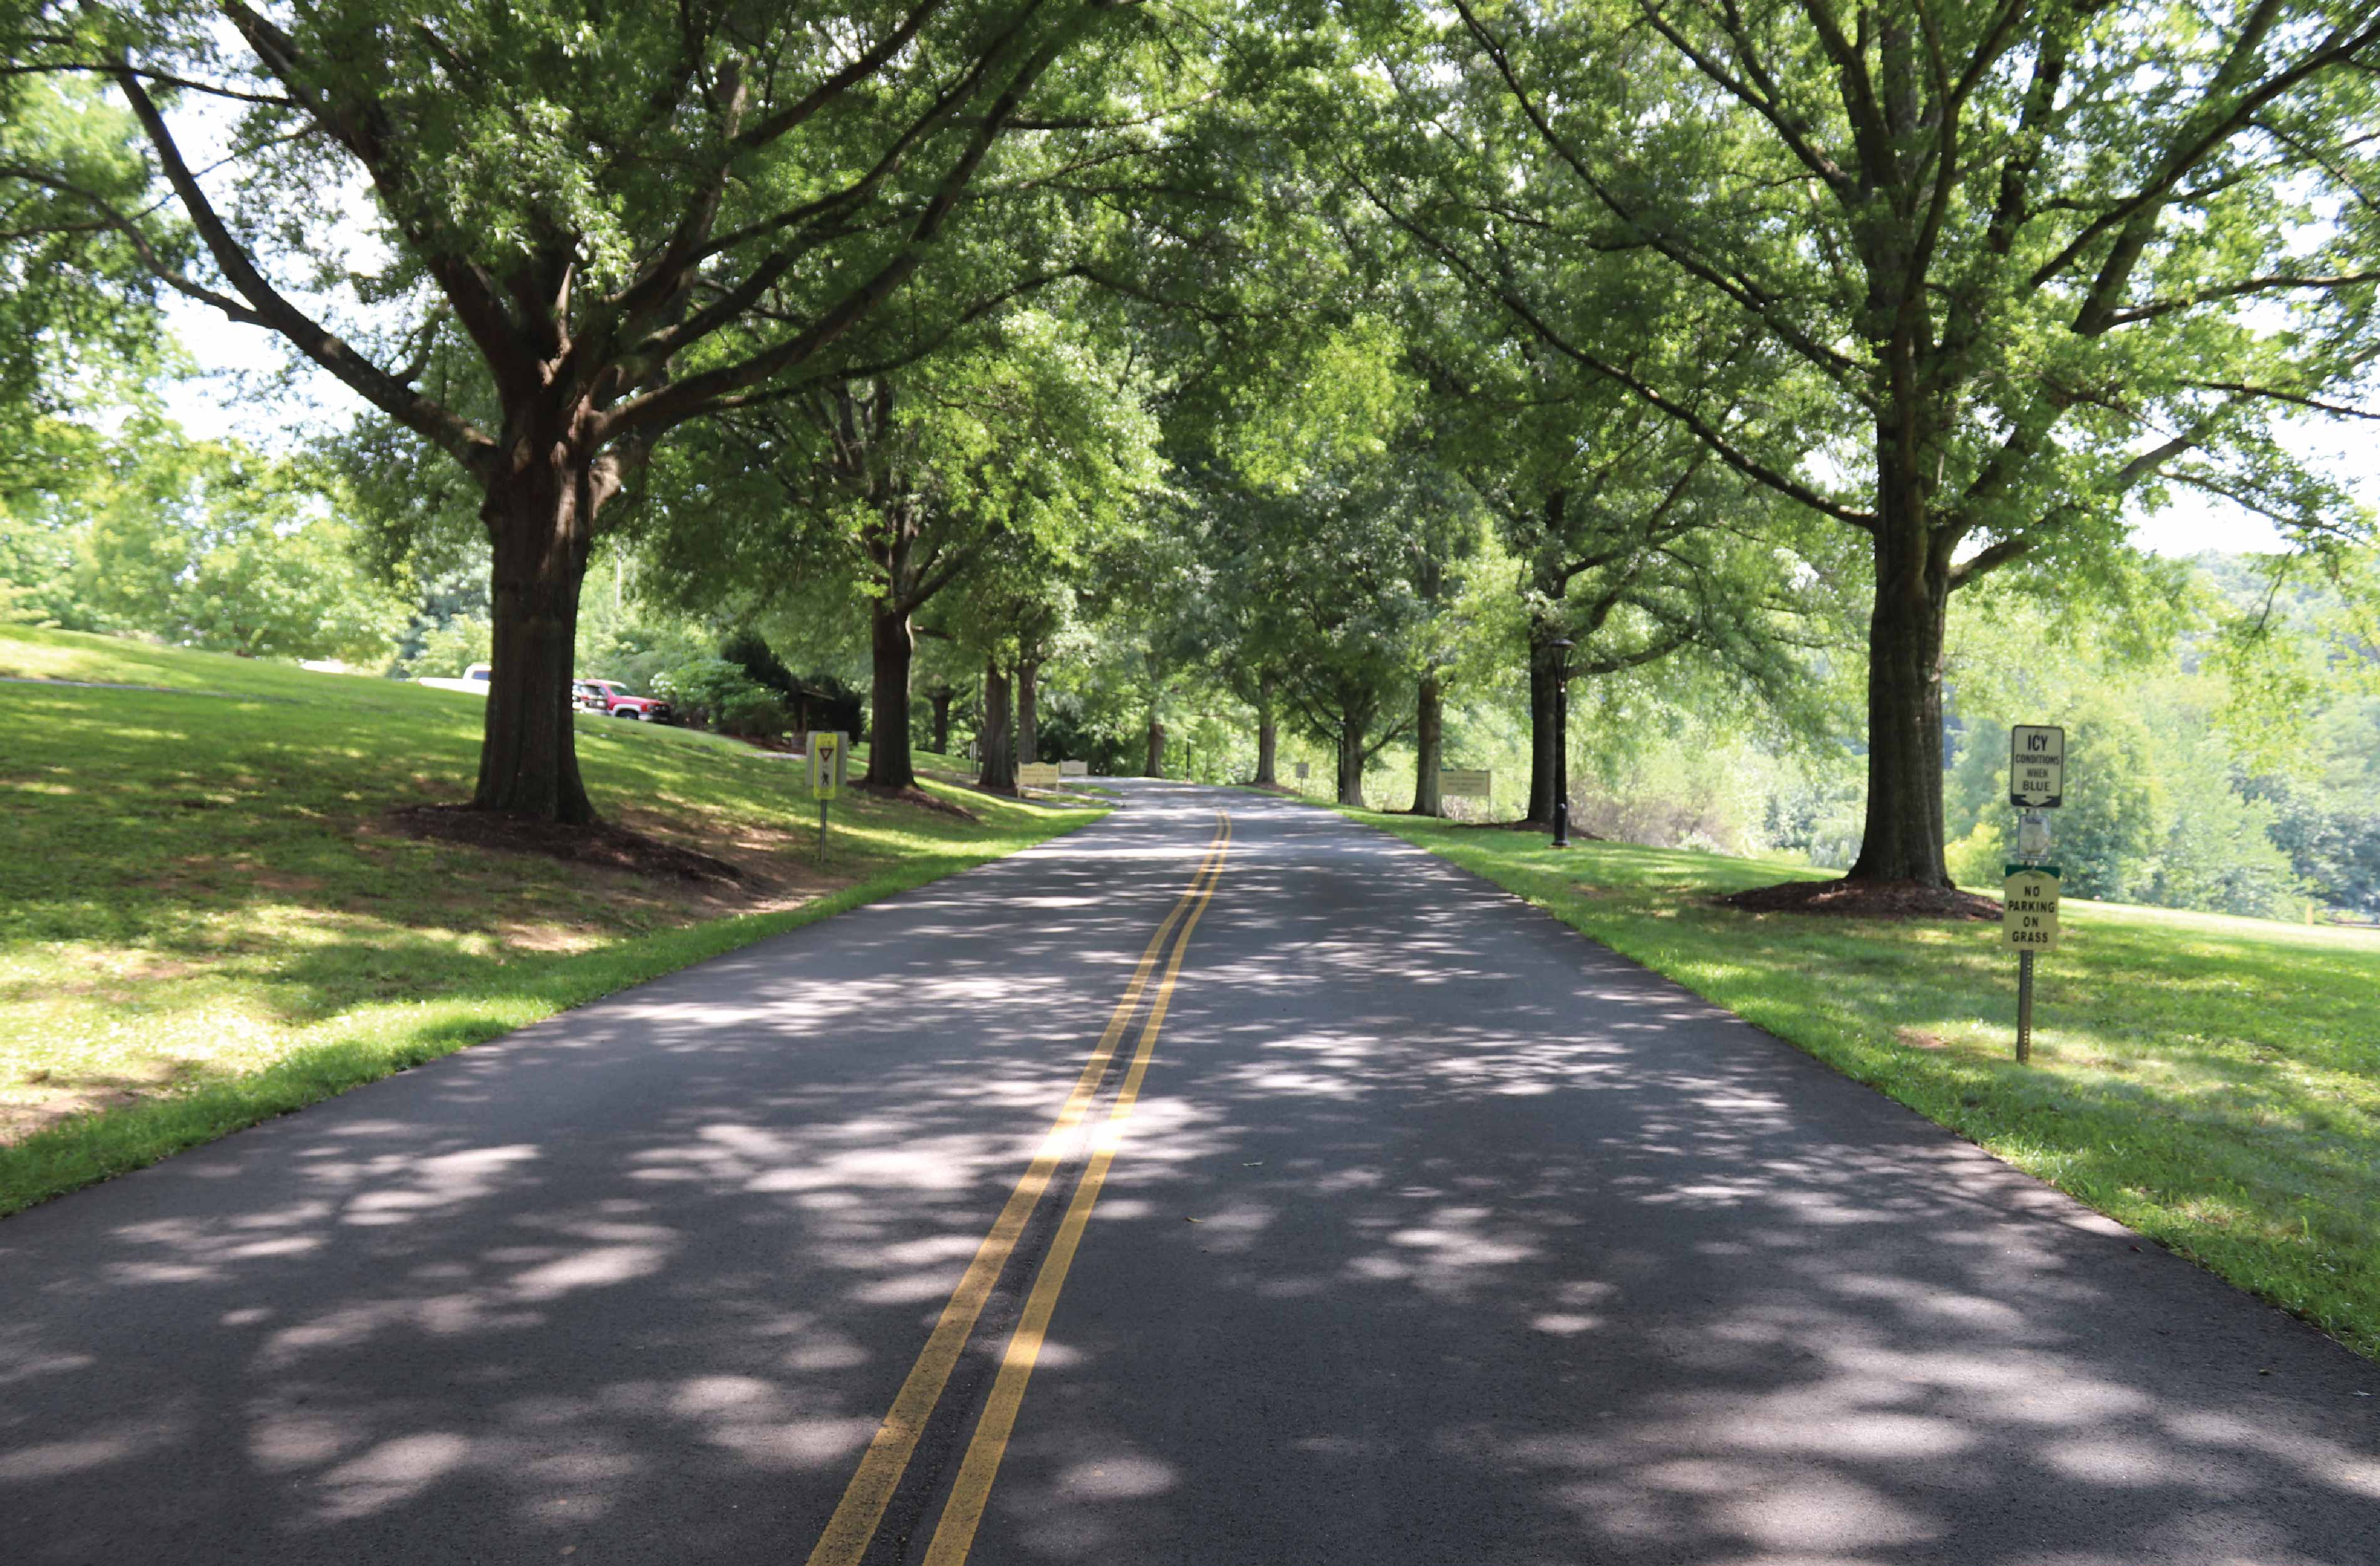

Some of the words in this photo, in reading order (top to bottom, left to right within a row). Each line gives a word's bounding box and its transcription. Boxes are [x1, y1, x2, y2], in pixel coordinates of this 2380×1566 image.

[2027, 734, 2048, 750] ICY
[2015, 754, 2059, 765] CONDITIONS
[2027, 768, 2048, 777] WHEN
[2023, 780, 2051, 791] BLUE
[2024, 886, 2040, 896] NO
[2009, 901, 2054, 913] PARKING
[2024, 916, 2039, 927] ON
[2012, 931, 2048, 942] GRASS
